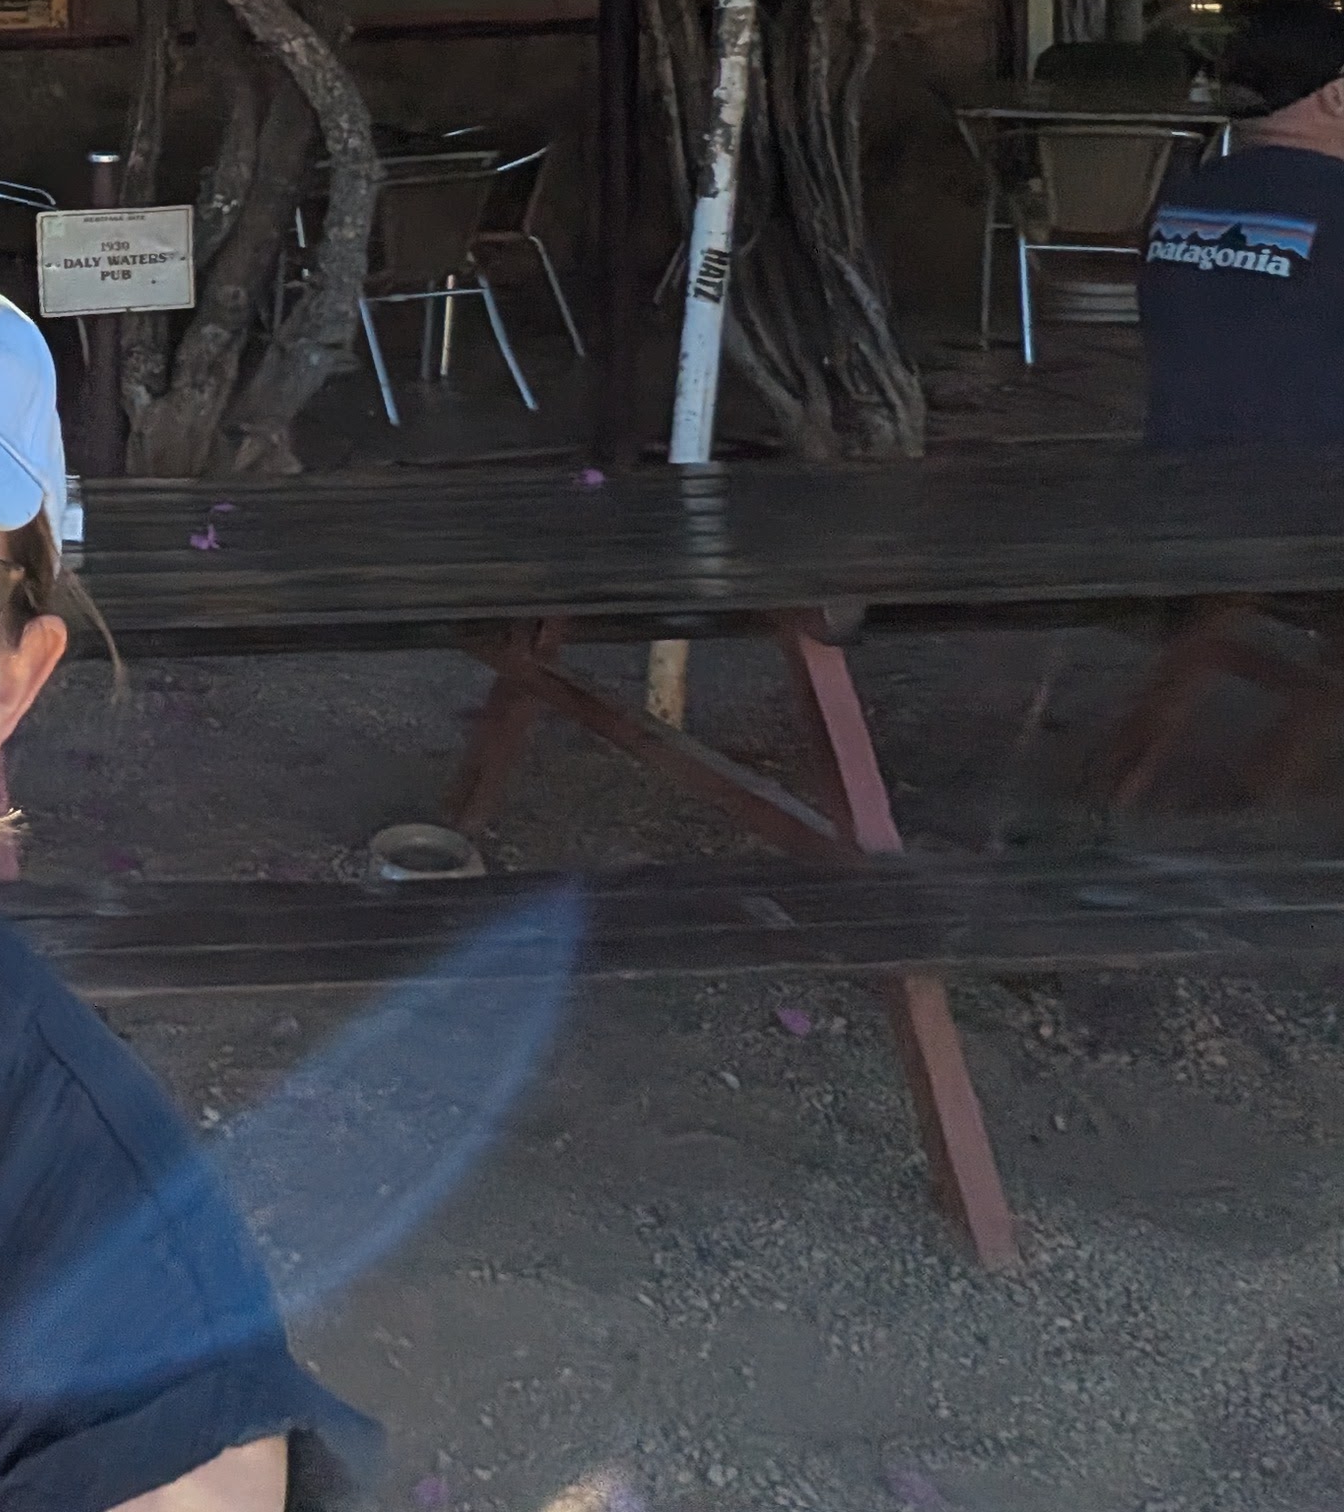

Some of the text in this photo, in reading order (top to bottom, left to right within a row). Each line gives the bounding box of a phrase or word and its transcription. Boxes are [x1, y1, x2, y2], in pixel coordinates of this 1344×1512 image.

[100, 241, 130, 252] 1930
[63, 252, 168, 269] DALY WATERS
[1146, 240, 1292, 278] patagonia
[100, 270, 132, 281] PUB
